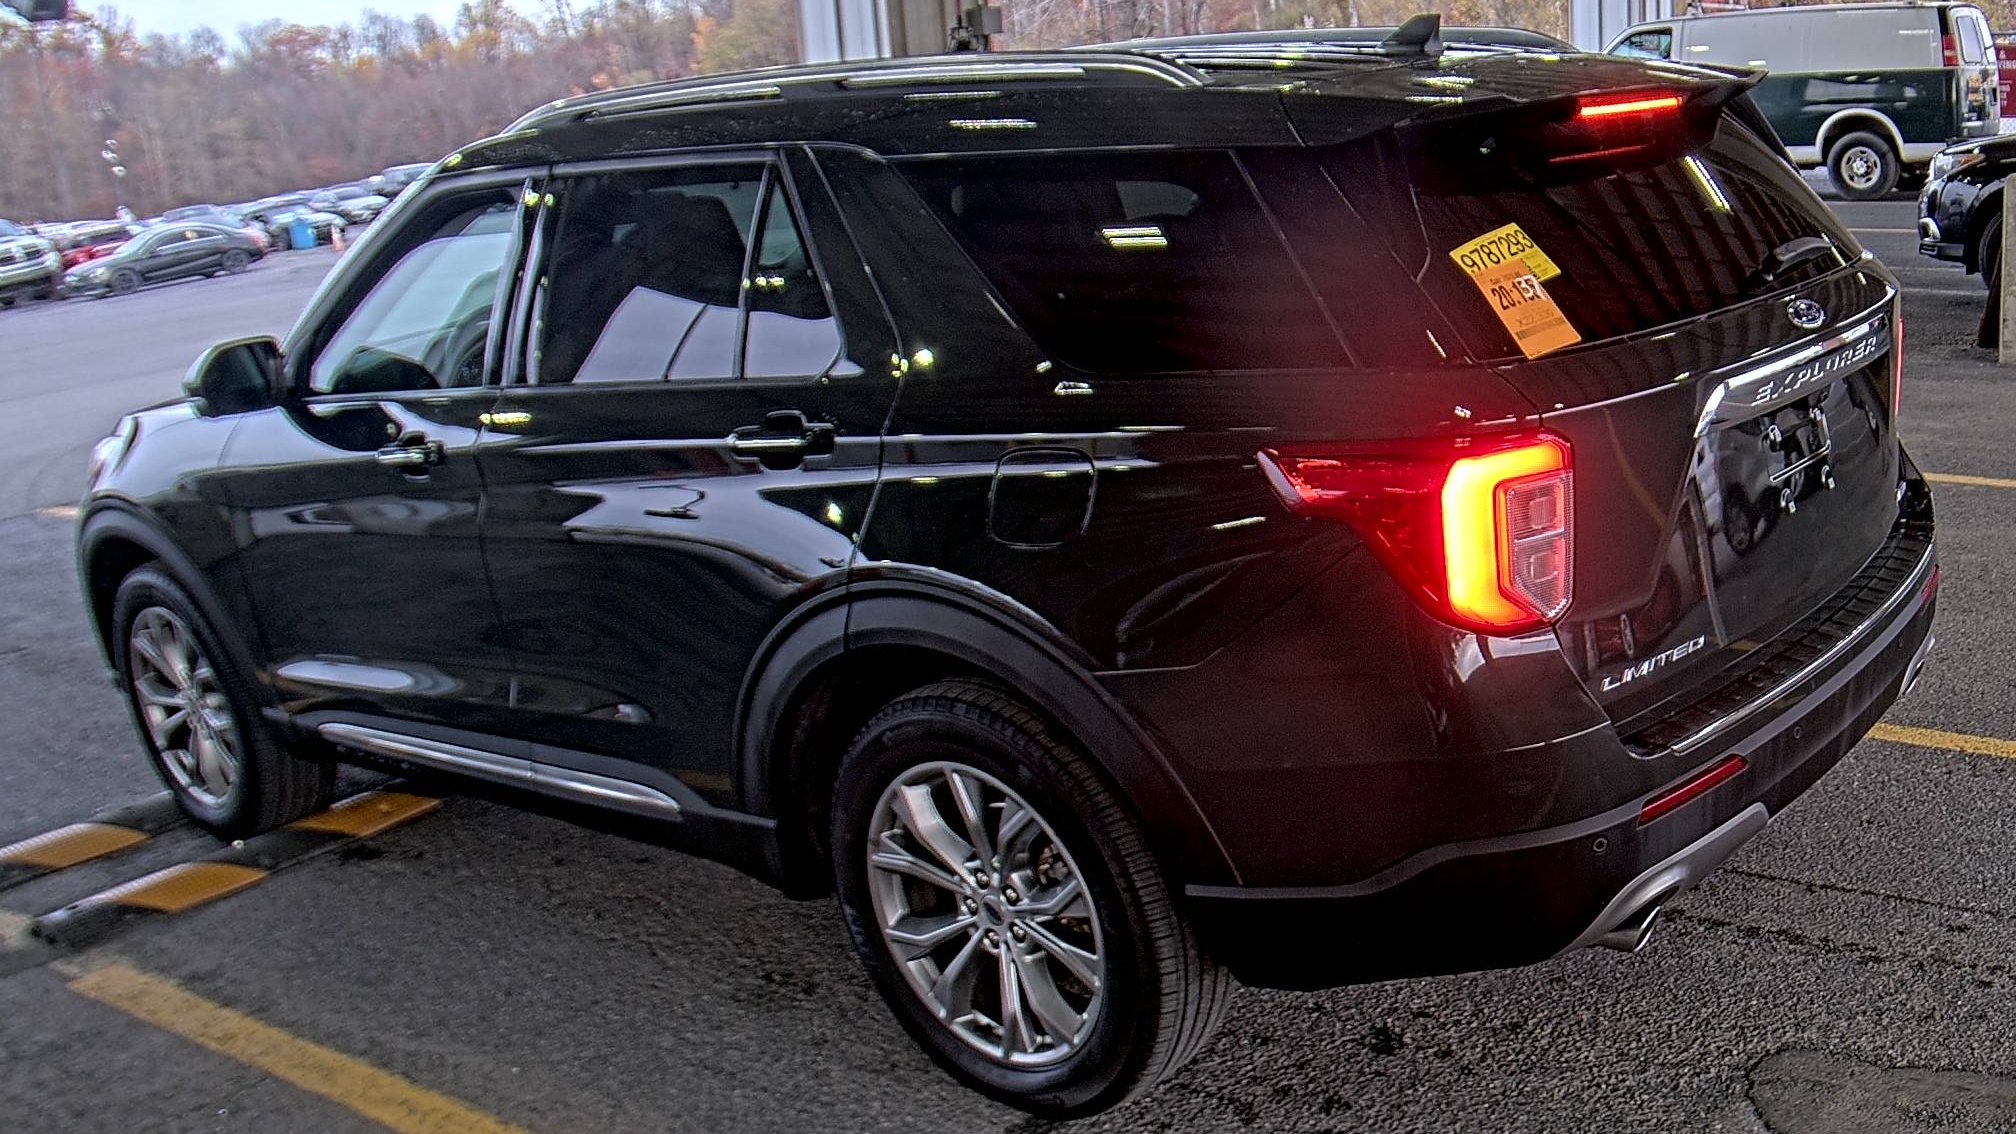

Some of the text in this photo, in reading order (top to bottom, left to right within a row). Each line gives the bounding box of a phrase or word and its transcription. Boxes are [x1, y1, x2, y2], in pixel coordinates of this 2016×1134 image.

[1460, 229, 1534, 272] 9787293
[1751, 336, 1877, 406] EXPLORER
[1601, 635, 1705, 691] LIMITED
